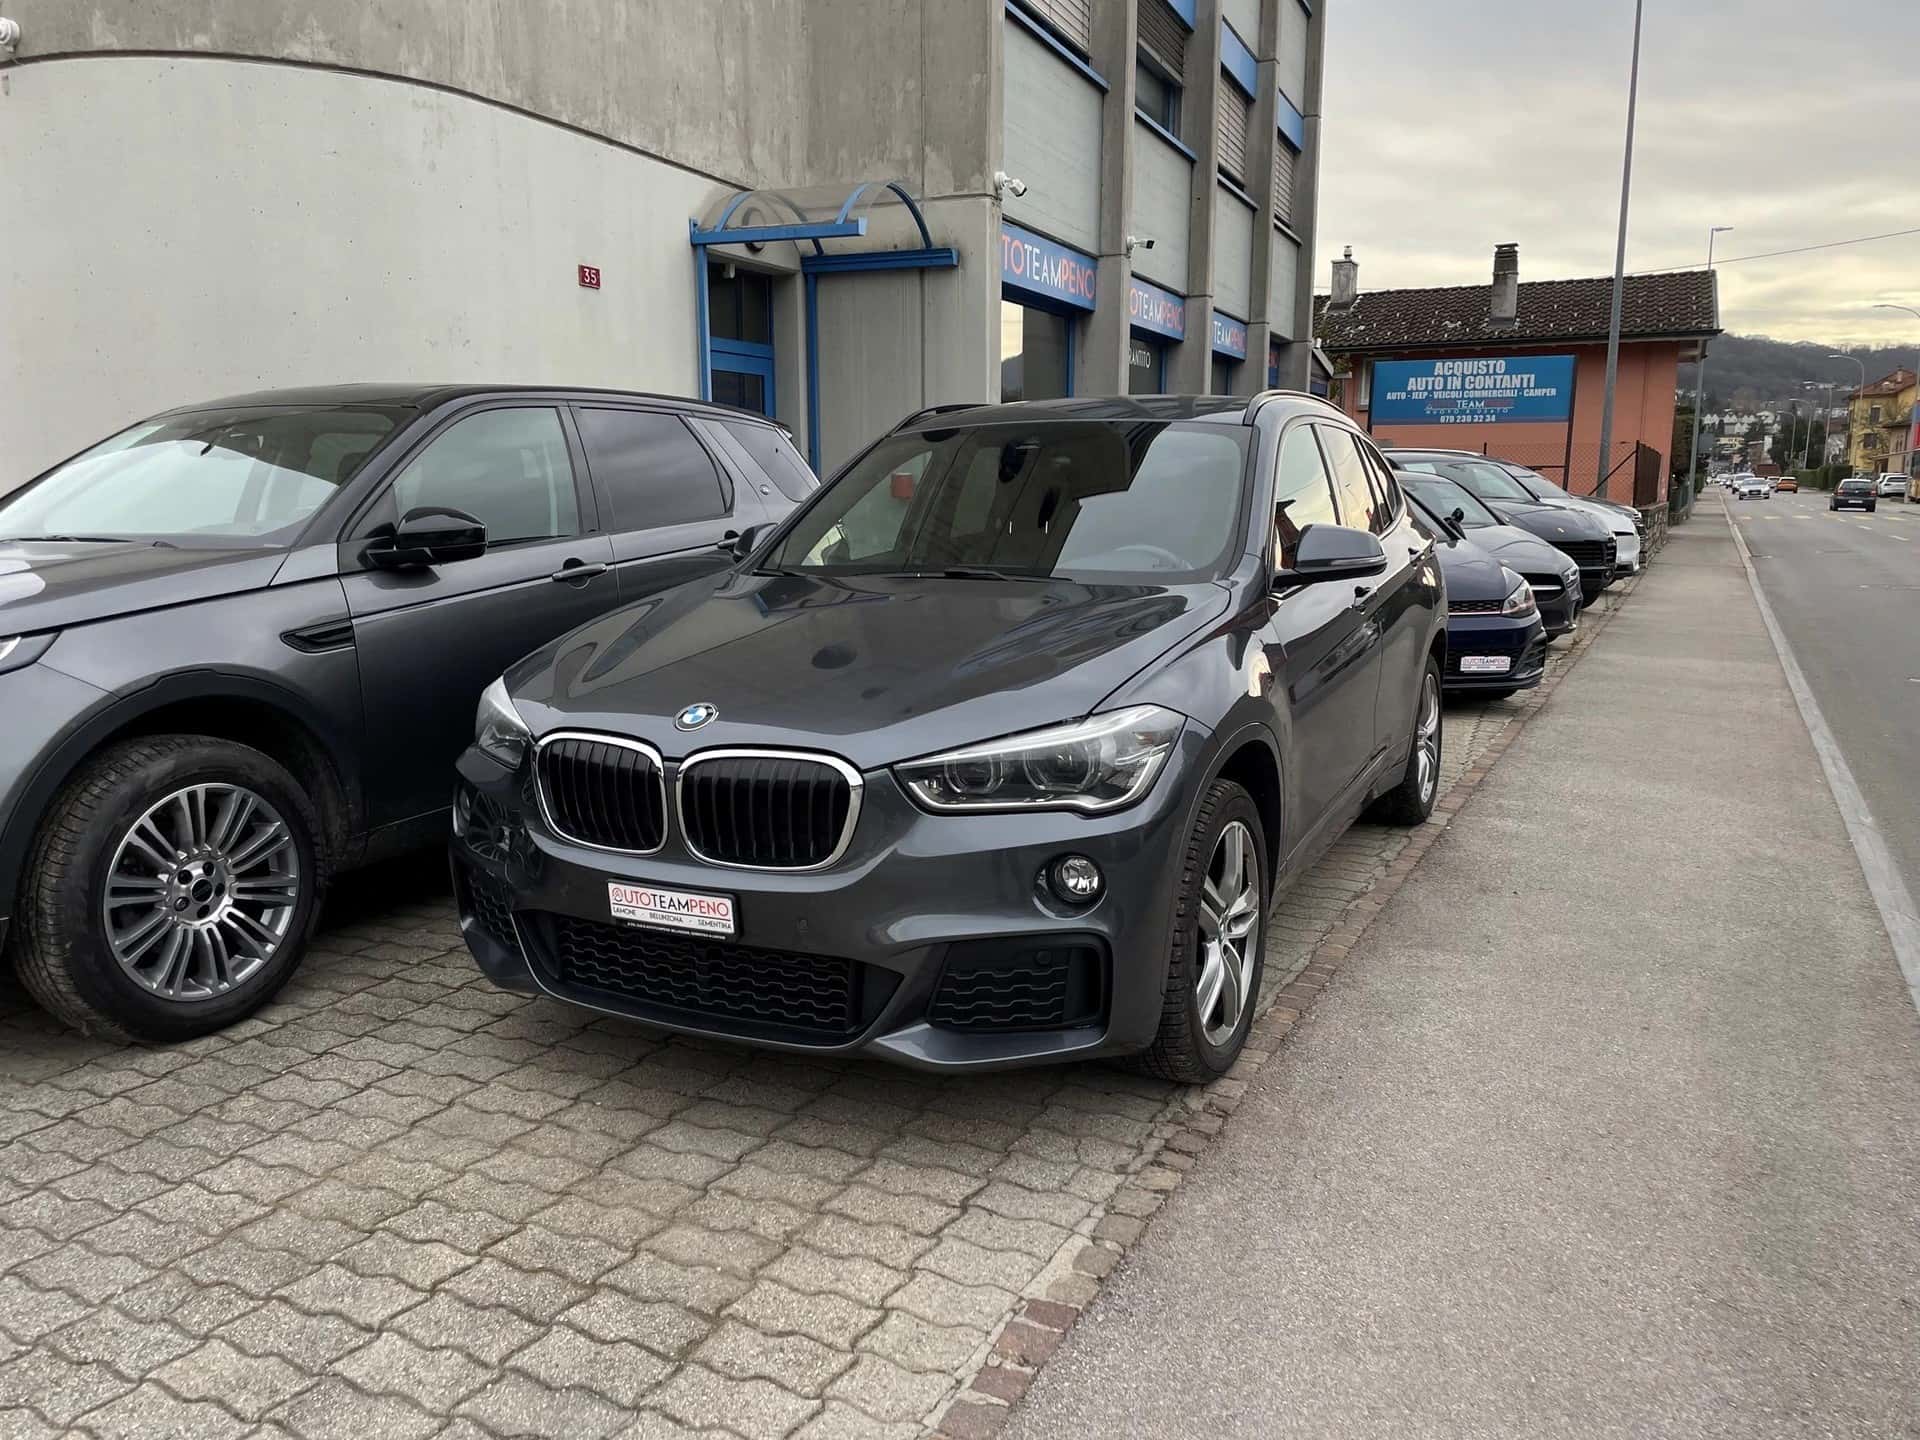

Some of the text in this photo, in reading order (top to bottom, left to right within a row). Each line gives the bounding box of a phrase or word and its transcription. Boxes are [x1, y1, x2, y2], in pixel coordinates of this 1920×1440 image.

[1001, 234, 1095, 299] TOTEAMPENO
[584, 268, 597, 284] 35
[1130, 287, 1184, 333] OTEAMPENO
[1434, 360, 1506, 376] ACQUISTO
[1407, 374, 1535, 391] AUTO IN CONTANTI
[1386, 391, 1406, 400] AUTO
[1433, 390, 1462, 399] VEICOLI
[1464, 389, 1518, 398] COMMERCIALI
[1523, 388, 1556, 397] CAMPER
